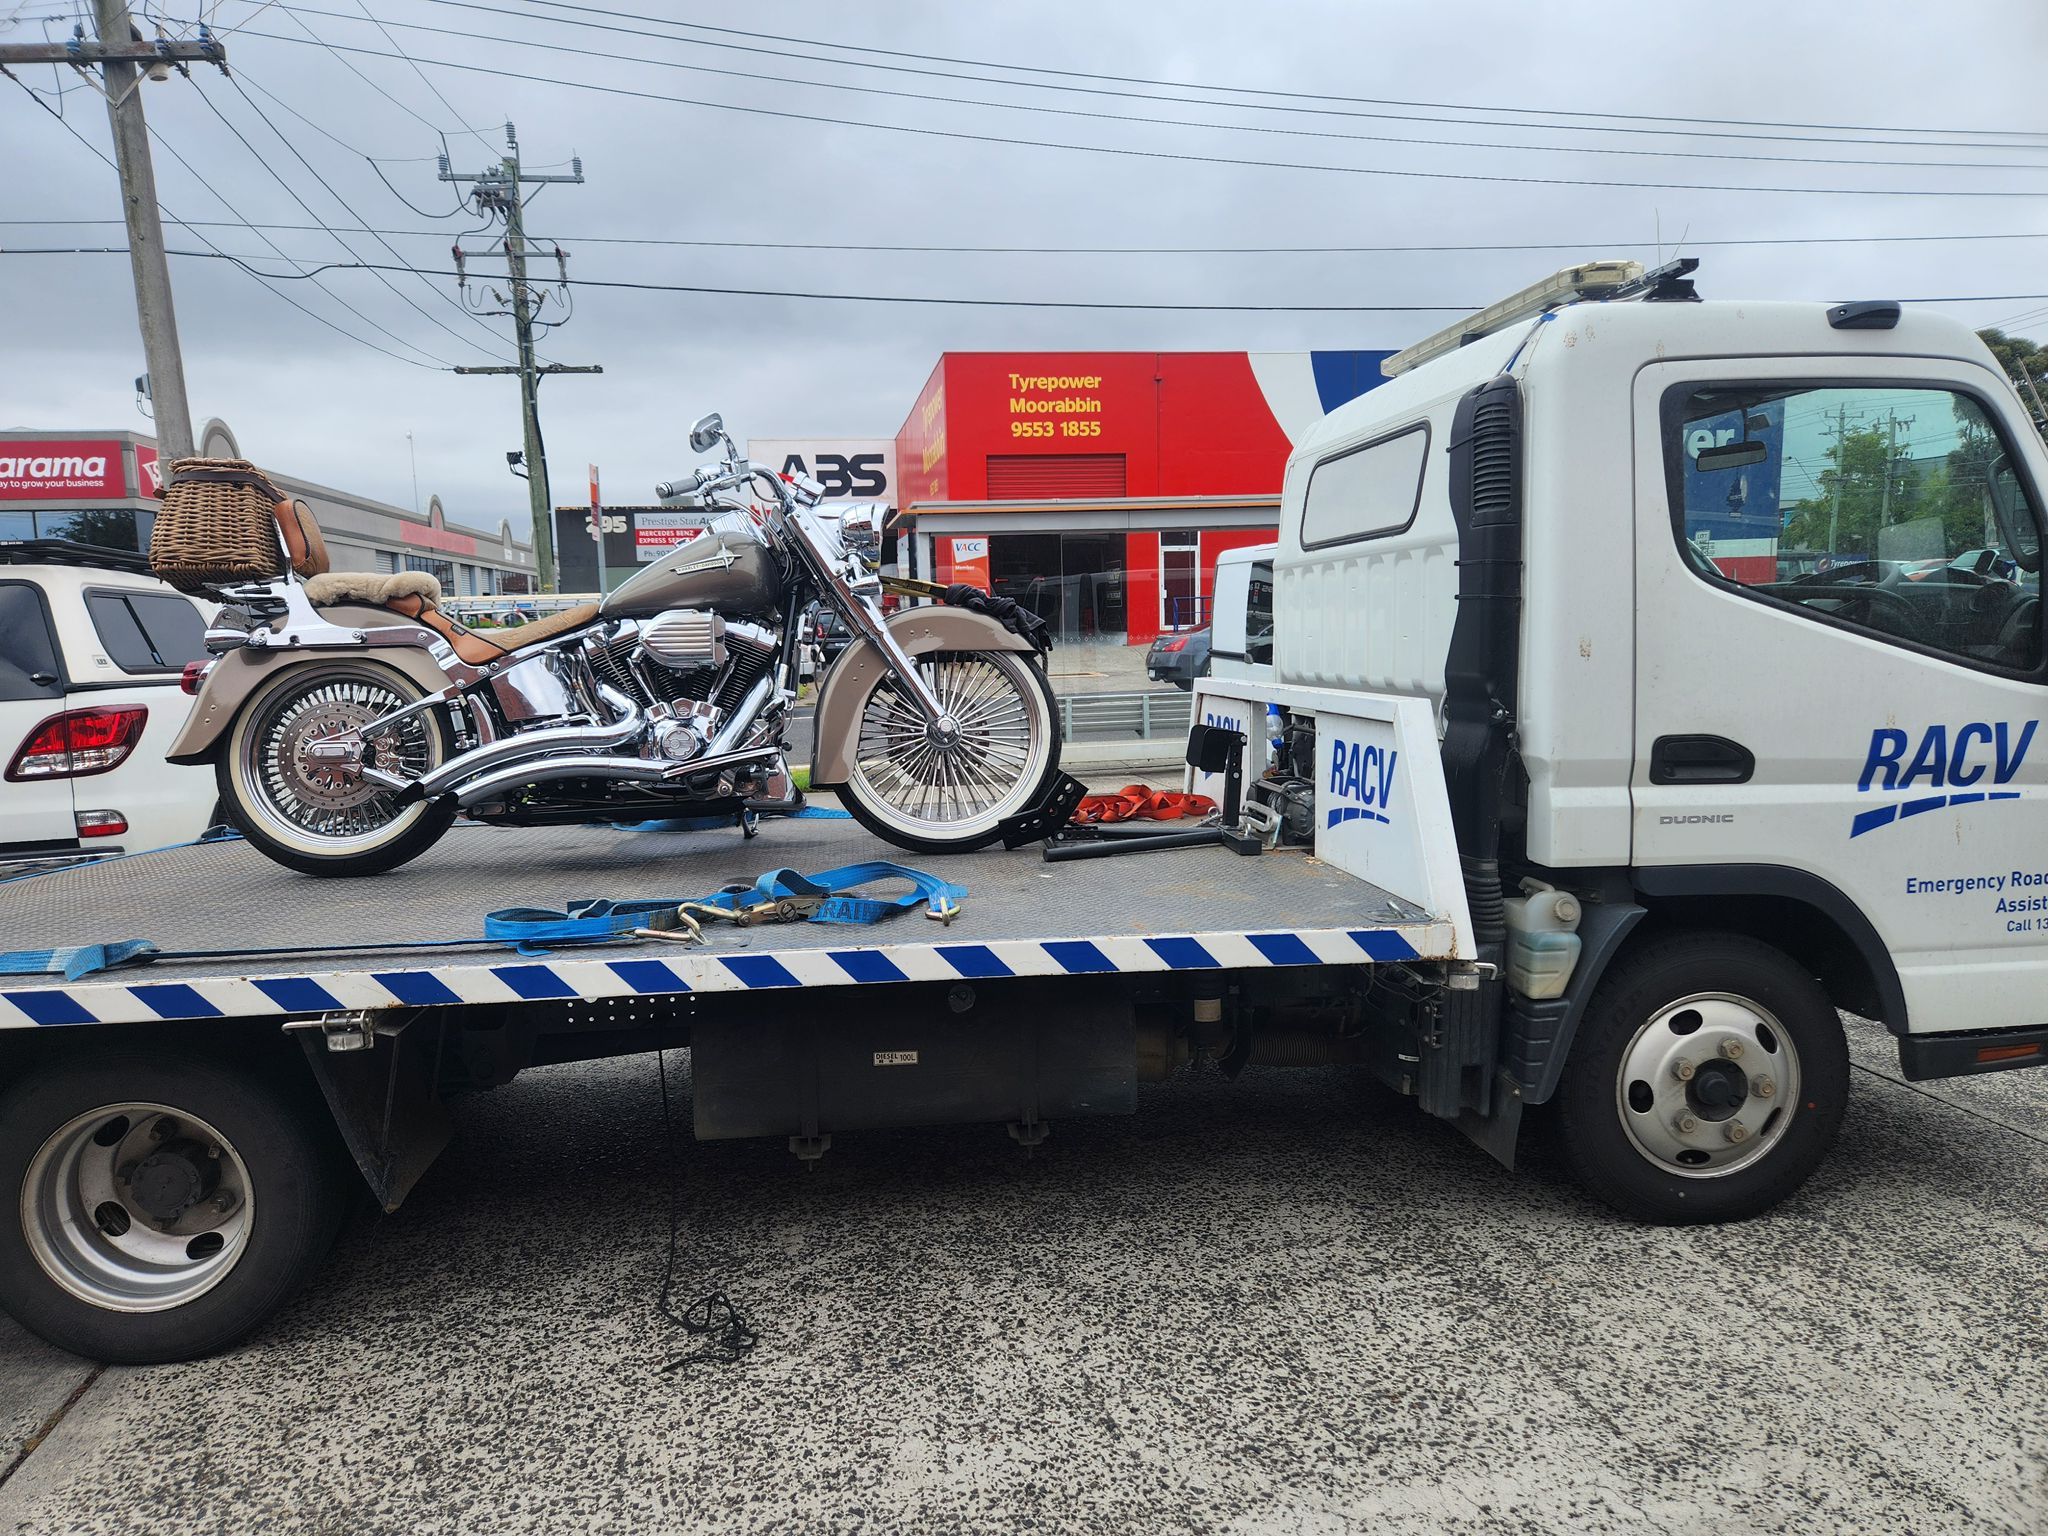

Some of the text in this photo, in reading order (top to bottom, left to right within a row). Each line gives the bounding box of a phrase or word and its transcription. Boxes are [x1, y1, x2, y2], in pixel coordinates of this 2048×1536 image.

[1008, 373, 1102, 393] Tyrepower
[1009, 397, 1101, 413] Moorabbin
[1010, 421, 1101, 437] 9553 1855
[1682, 428, 1735, 459] er
[780, 453, 887, 497] ABS
[10, 480, 20, 488] to
[22, 481, 43, 490] grow
[45, 480, 65, 489] your
[66, 479, 104, 487] business
[641, 516, 678, 527] Prestige
[680, 516, 698, 526] Star
[956, 543, 981, 552] VACC
[1857, 720, 2039, 792] RACV
[1330, 739, 1397, 809] RACV
[1660, 814, 1734, 825] DUONIC
[1906, 875, 2006, 895] Emergency
[1995, 896, 2048, 913] Assist
[2007, 919, 2031, 932] Call
